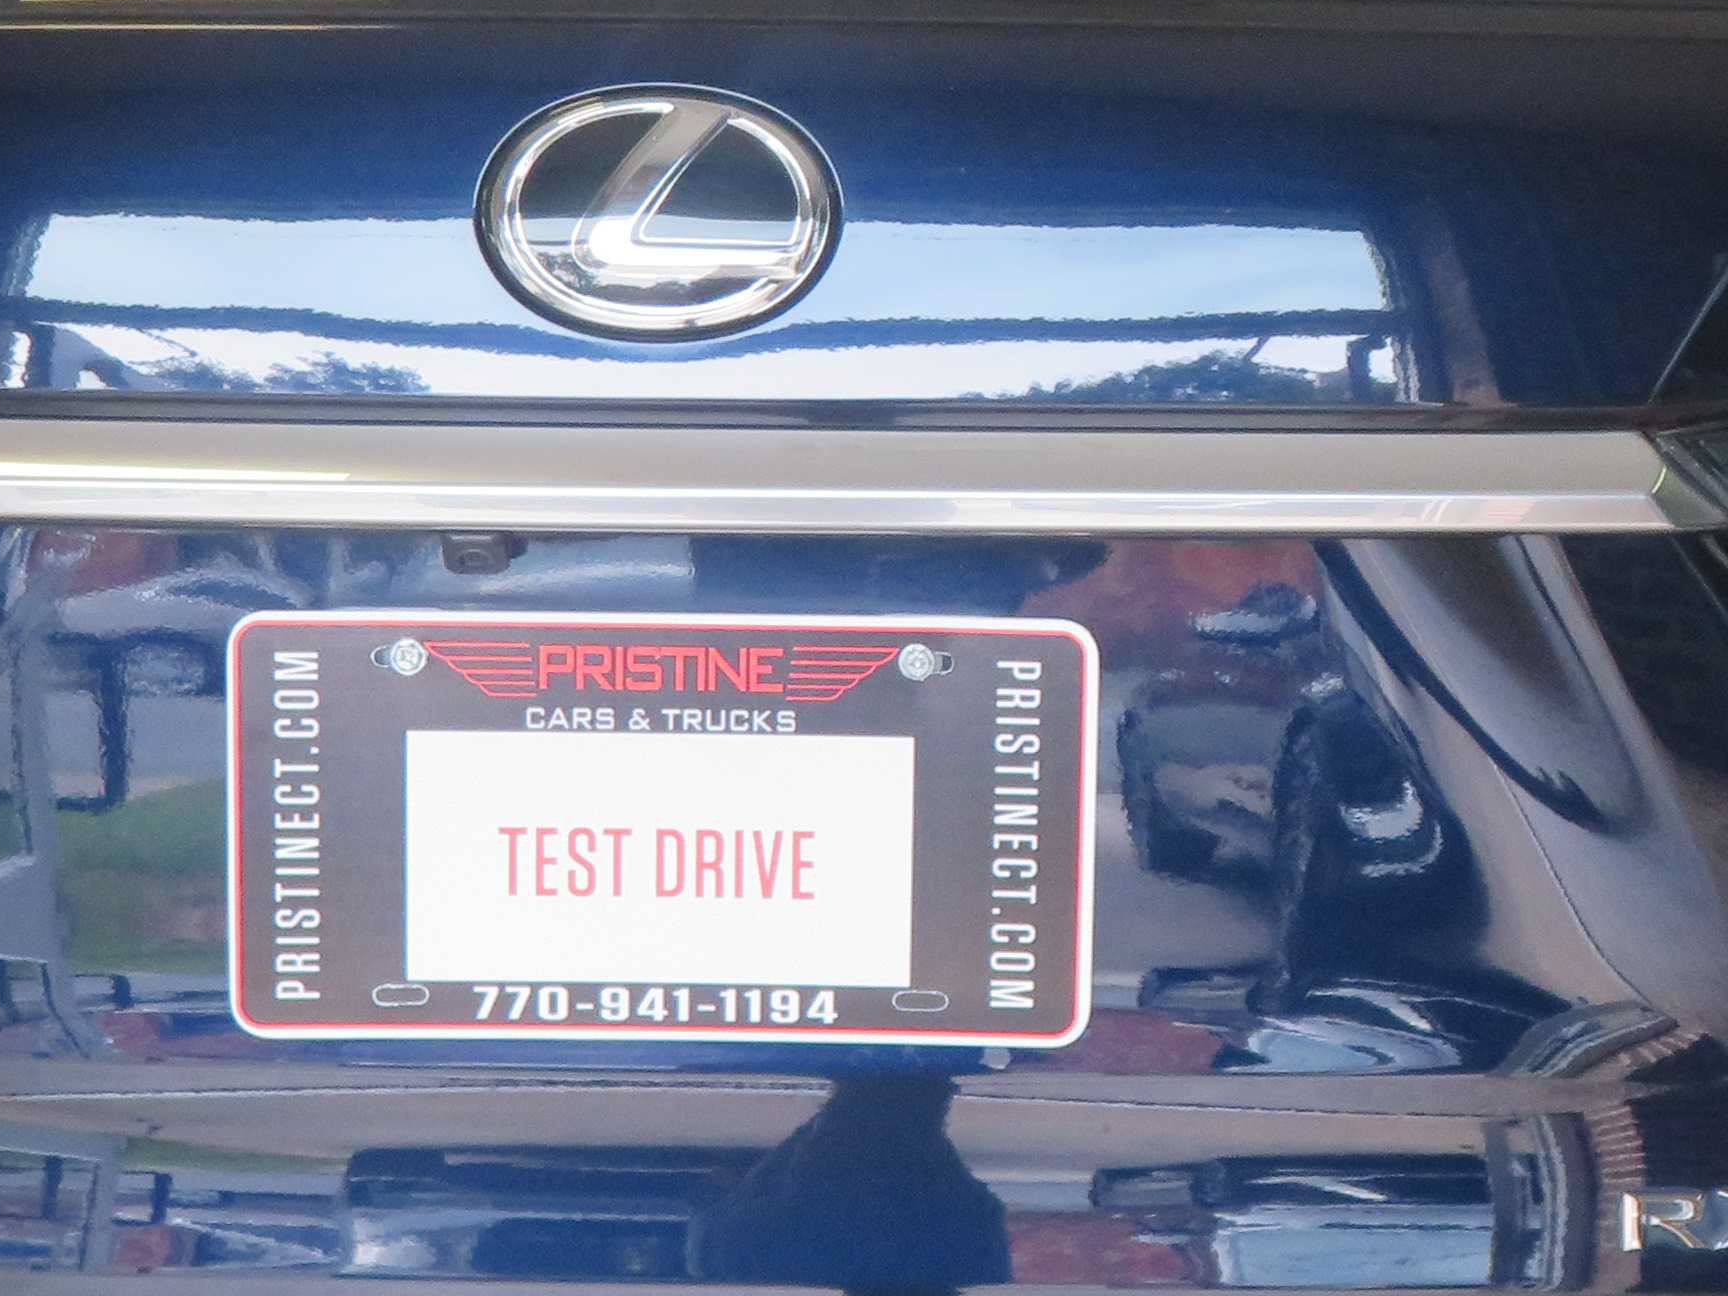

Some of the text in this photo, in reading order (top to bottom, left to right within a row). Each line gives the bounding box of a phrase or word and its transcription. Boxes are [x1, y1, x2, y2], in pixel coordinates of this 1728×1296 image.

[536, 642, 787, 694] PRISTINE
[524, 706, 797, 733] CARS & TRUCKS
[273, 649, 321, 1001] PRISTINECT.COM
[988, 660, 1043, 1009] PRISTINECT.COM
[497, 826, 815, 900] TEST DRIVE
[472, 985, 839, 1025] 770-941-1194
